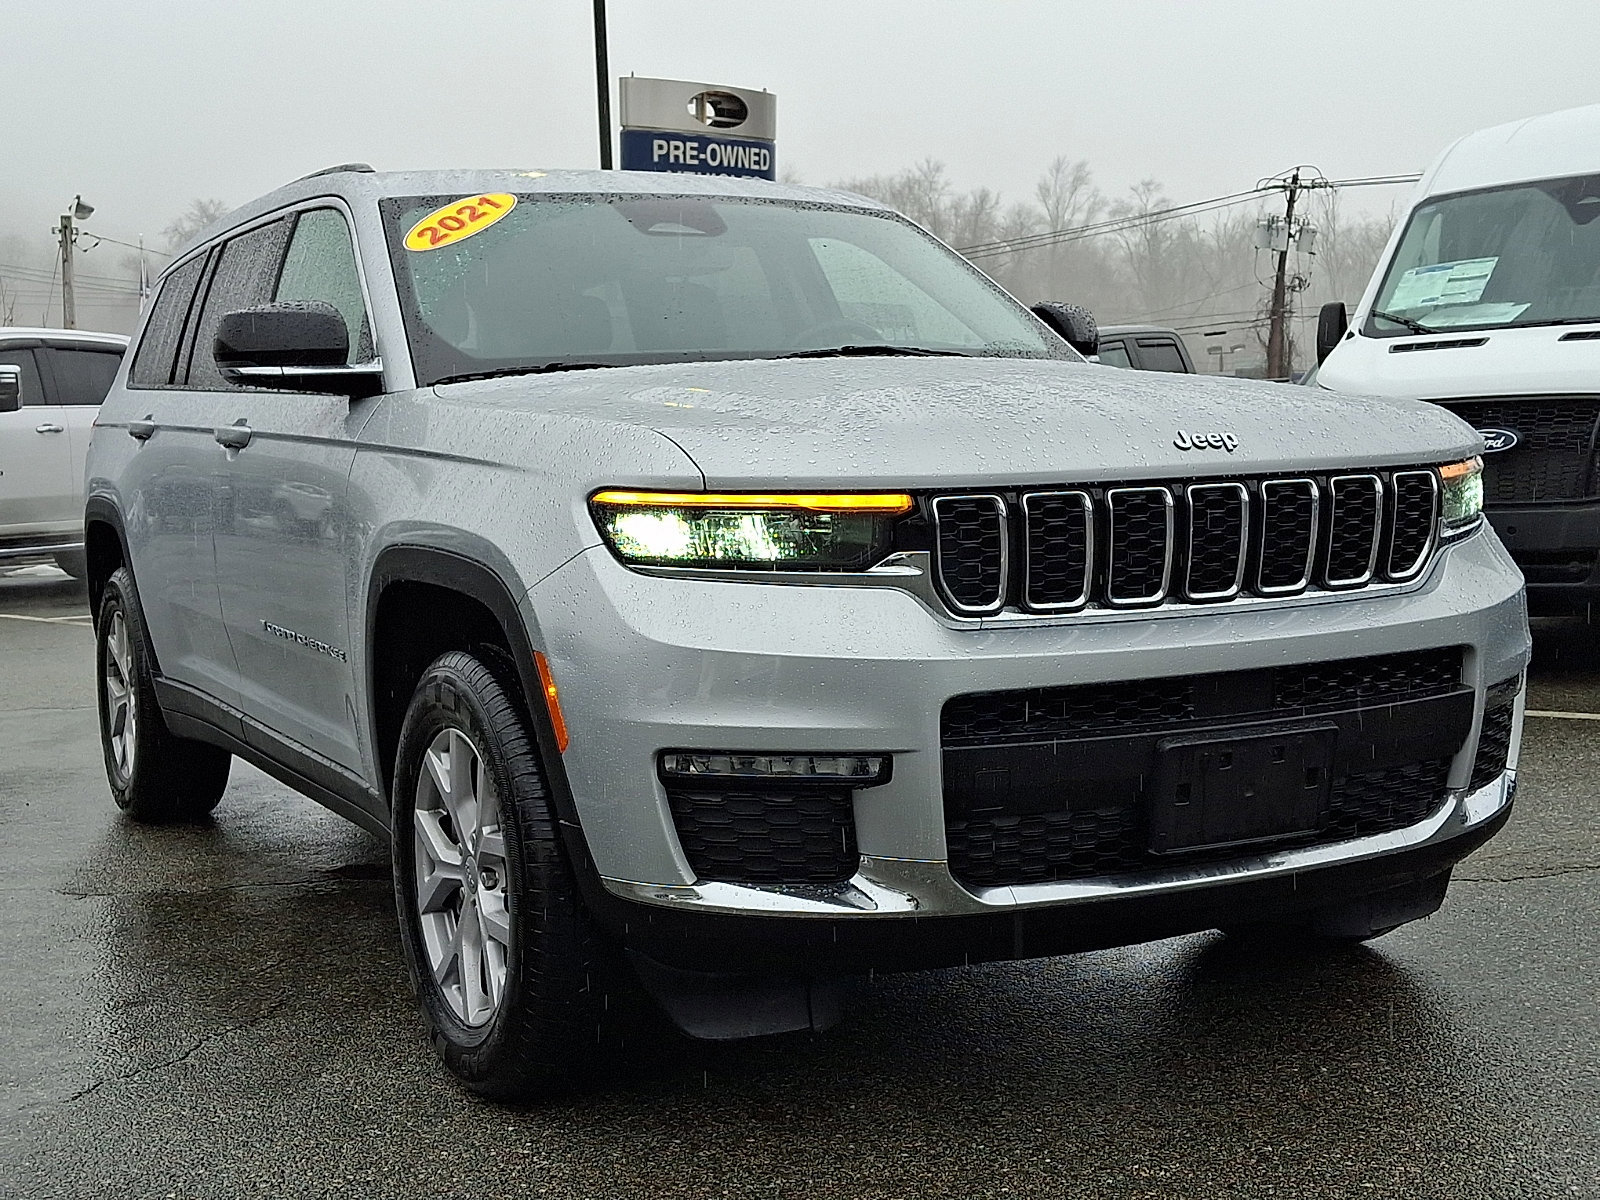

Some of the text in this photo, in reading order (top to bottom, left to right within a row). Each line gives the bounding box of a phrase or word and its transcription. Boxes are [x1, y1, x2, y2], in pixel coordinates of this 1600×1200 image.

[653, 139, 770, 171] PRE-OWNED
[416, 196, 502, 246] 2021
[1173, 430, 1239, 453] Jeep
